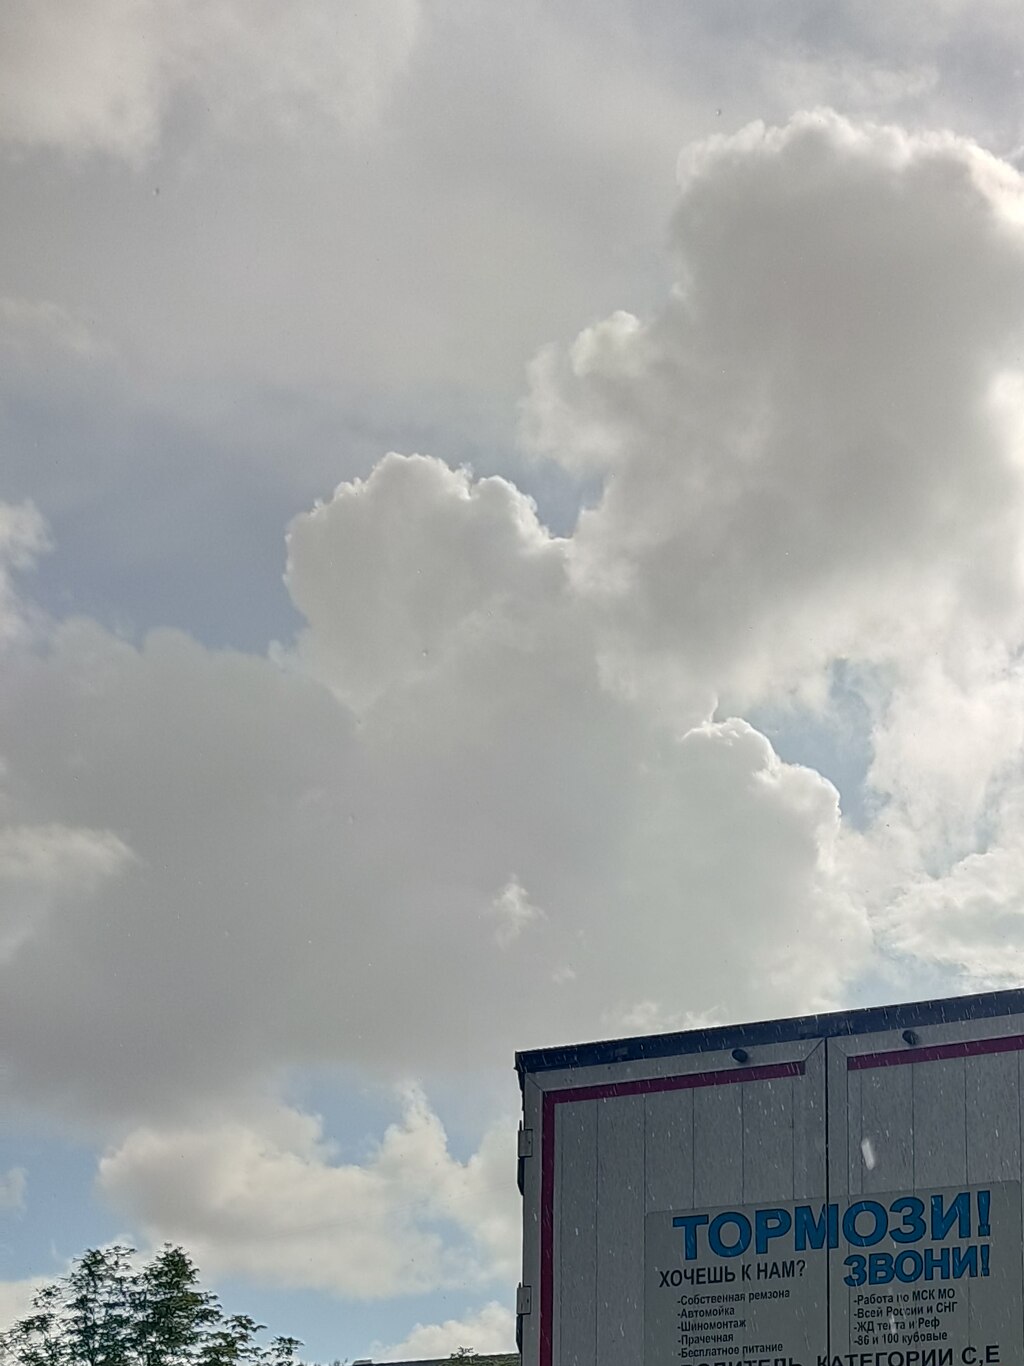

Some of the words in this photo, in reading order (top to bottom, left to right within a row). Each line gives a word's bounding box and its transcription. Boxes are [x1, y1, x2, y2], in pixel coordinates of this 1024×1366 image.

[673, 1190, 991, 1260] ТОРМОЗИ!
[659, 1265, 735, 1288] ХОЧЕШЬ
[742, 1264, 752, 1281] К
[757, 1259, 806, 1280] НАМ?
[843, 1244, 990, 1287] ЗВОНИ!
[677, 1292, 745, 1306] -Собственная
[749, 1289, 790, 1303] ремзона
[854, 1294, 893, 1305] -Работа
[912, 1289, 936, 1301] МСК
[938, 1288, 955, 1299] МО
[677, 1306, 735, 1319] -Автомойка
[854, 1307, 882, 1319] -Всей
[927, 1306, 933, 1314] и
[936, 1302, 958, 1313] СНГ
[677, 1319, 746, 1332] -Шиномонтаж
[854, 1321, 875, 1334] -ЖД
[909, 1321, 915, 1329] и
[918, 1317, 940, 1330] Реф
[678, 1333, 734, 1346] -Прачечная
[872, 1336, 879, 1345] и
[882, 1333, 899, 1345] 100
[902, 1331, 948, 1345] кубовые
[678, 1346, 739, 1359] -Бесплатное
[742, 1343, 783, 1355] питание
[961, 1345, 1000, 1366] С,Е
